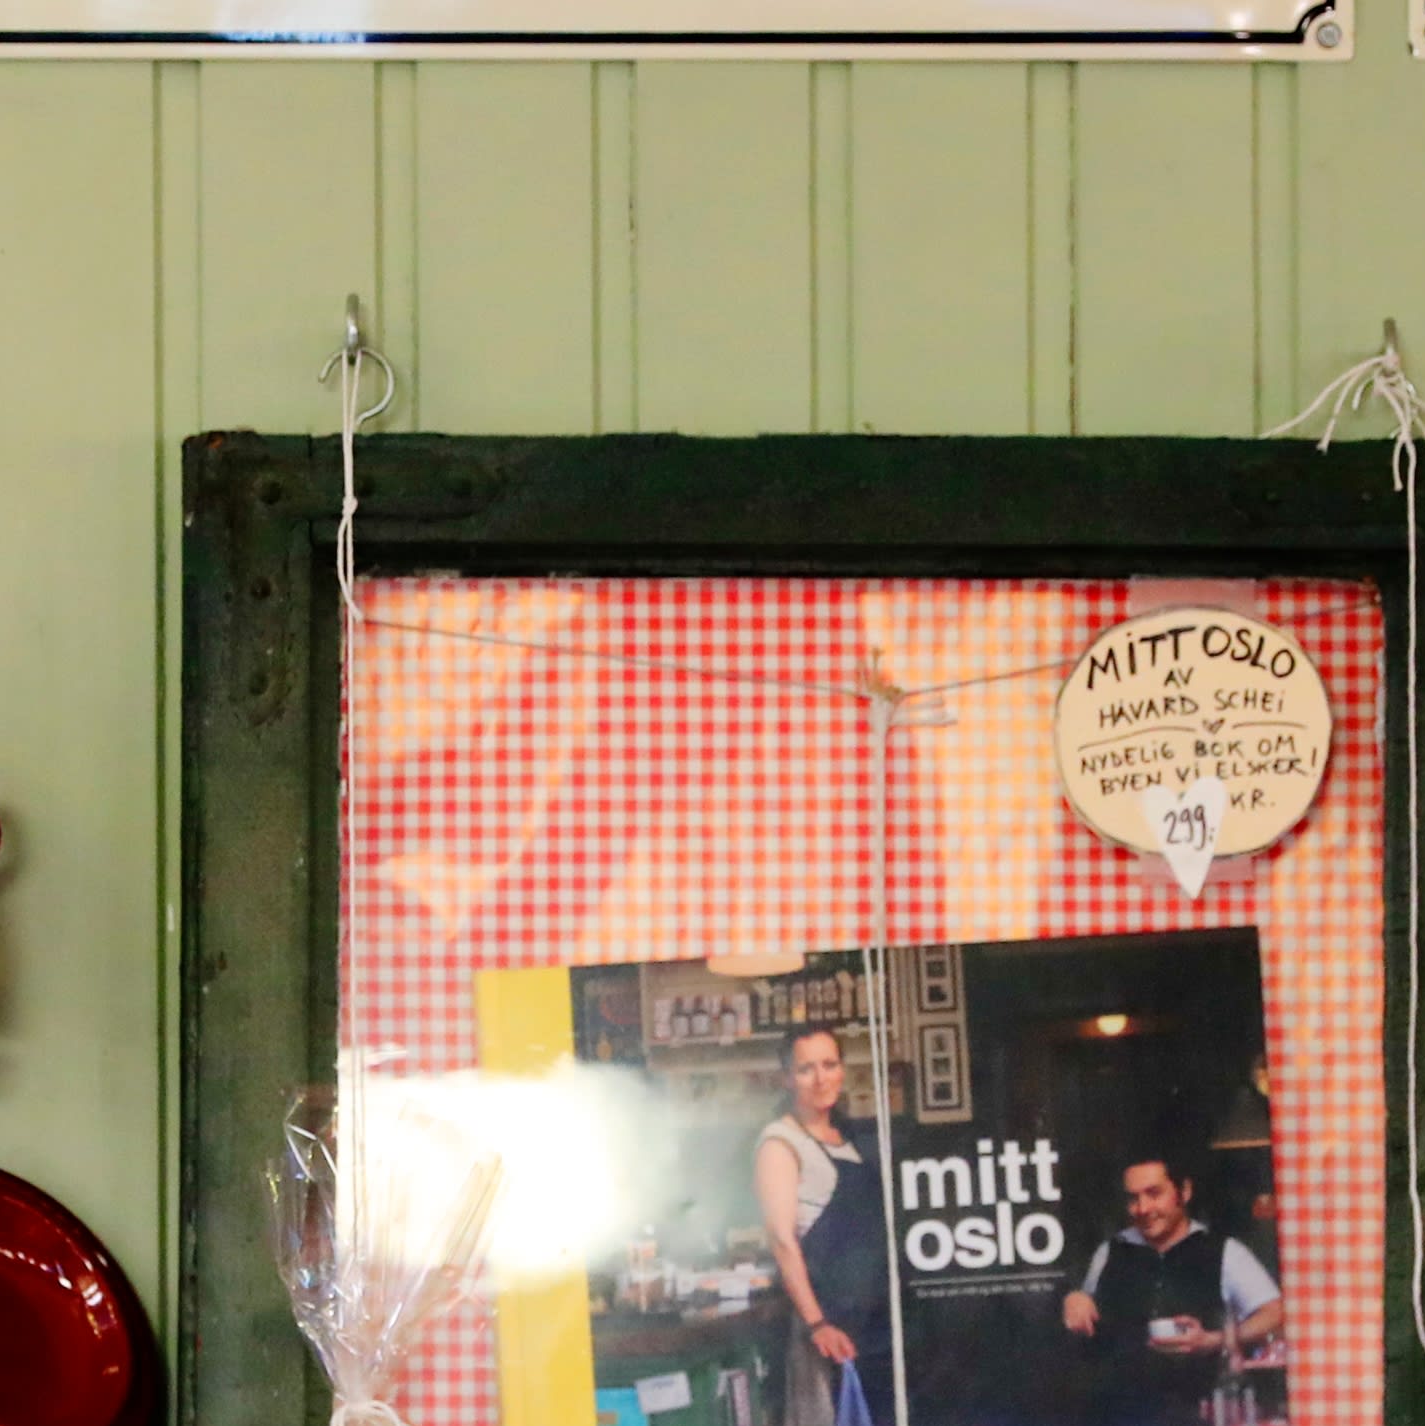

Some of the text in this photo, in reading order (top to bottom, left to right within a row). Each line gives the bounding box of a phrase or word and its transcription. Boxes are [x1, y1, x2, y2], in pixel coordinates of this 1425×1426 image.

[1163, 667, 1195, 689] AV
[1257, 734, 1297, 757] OM
[900, 1138, 1062, 1210] mitt
[905, 1200, 1065, 1271] oslo
